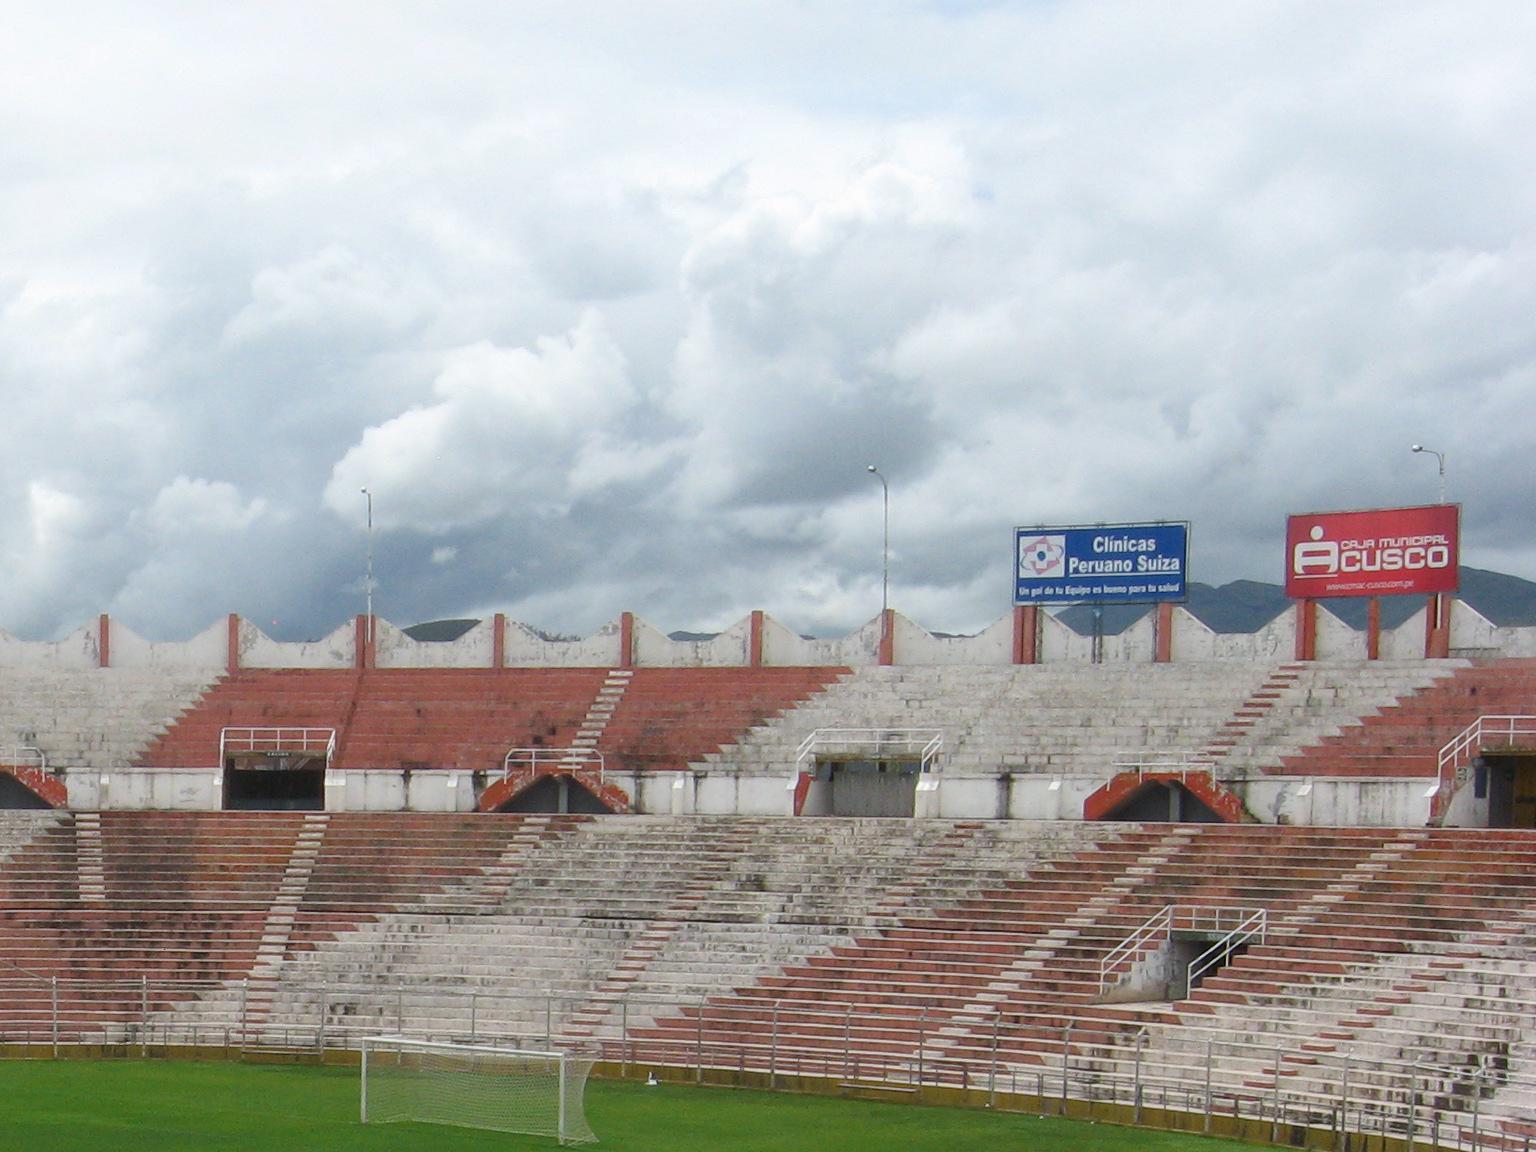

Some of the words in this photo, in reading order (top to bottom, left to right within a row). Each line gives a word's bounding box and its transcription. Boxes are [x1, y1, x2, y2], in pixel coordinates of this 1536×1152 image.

[1093, 536, 1156, 553] Clínicas
[1341, 540, 1375, 549] CAJA
[1379, 535, 1449, 548] MUNICIPAL
[1069, 557, 1133, 574] Peruano
[1137, 555, 1180, 571] Suiza
[1340, 546, 1449, 572] CUSCO
[1019, 587, 1030, 595] Un
[1044, 586, 1055, 594] de
[1065, 585, 1091, 595] Equipo
[1128, 586, 1146, 595] para
[1148, 584, 1157, 592] tu
[1158, 583, 1180, 592] salud
